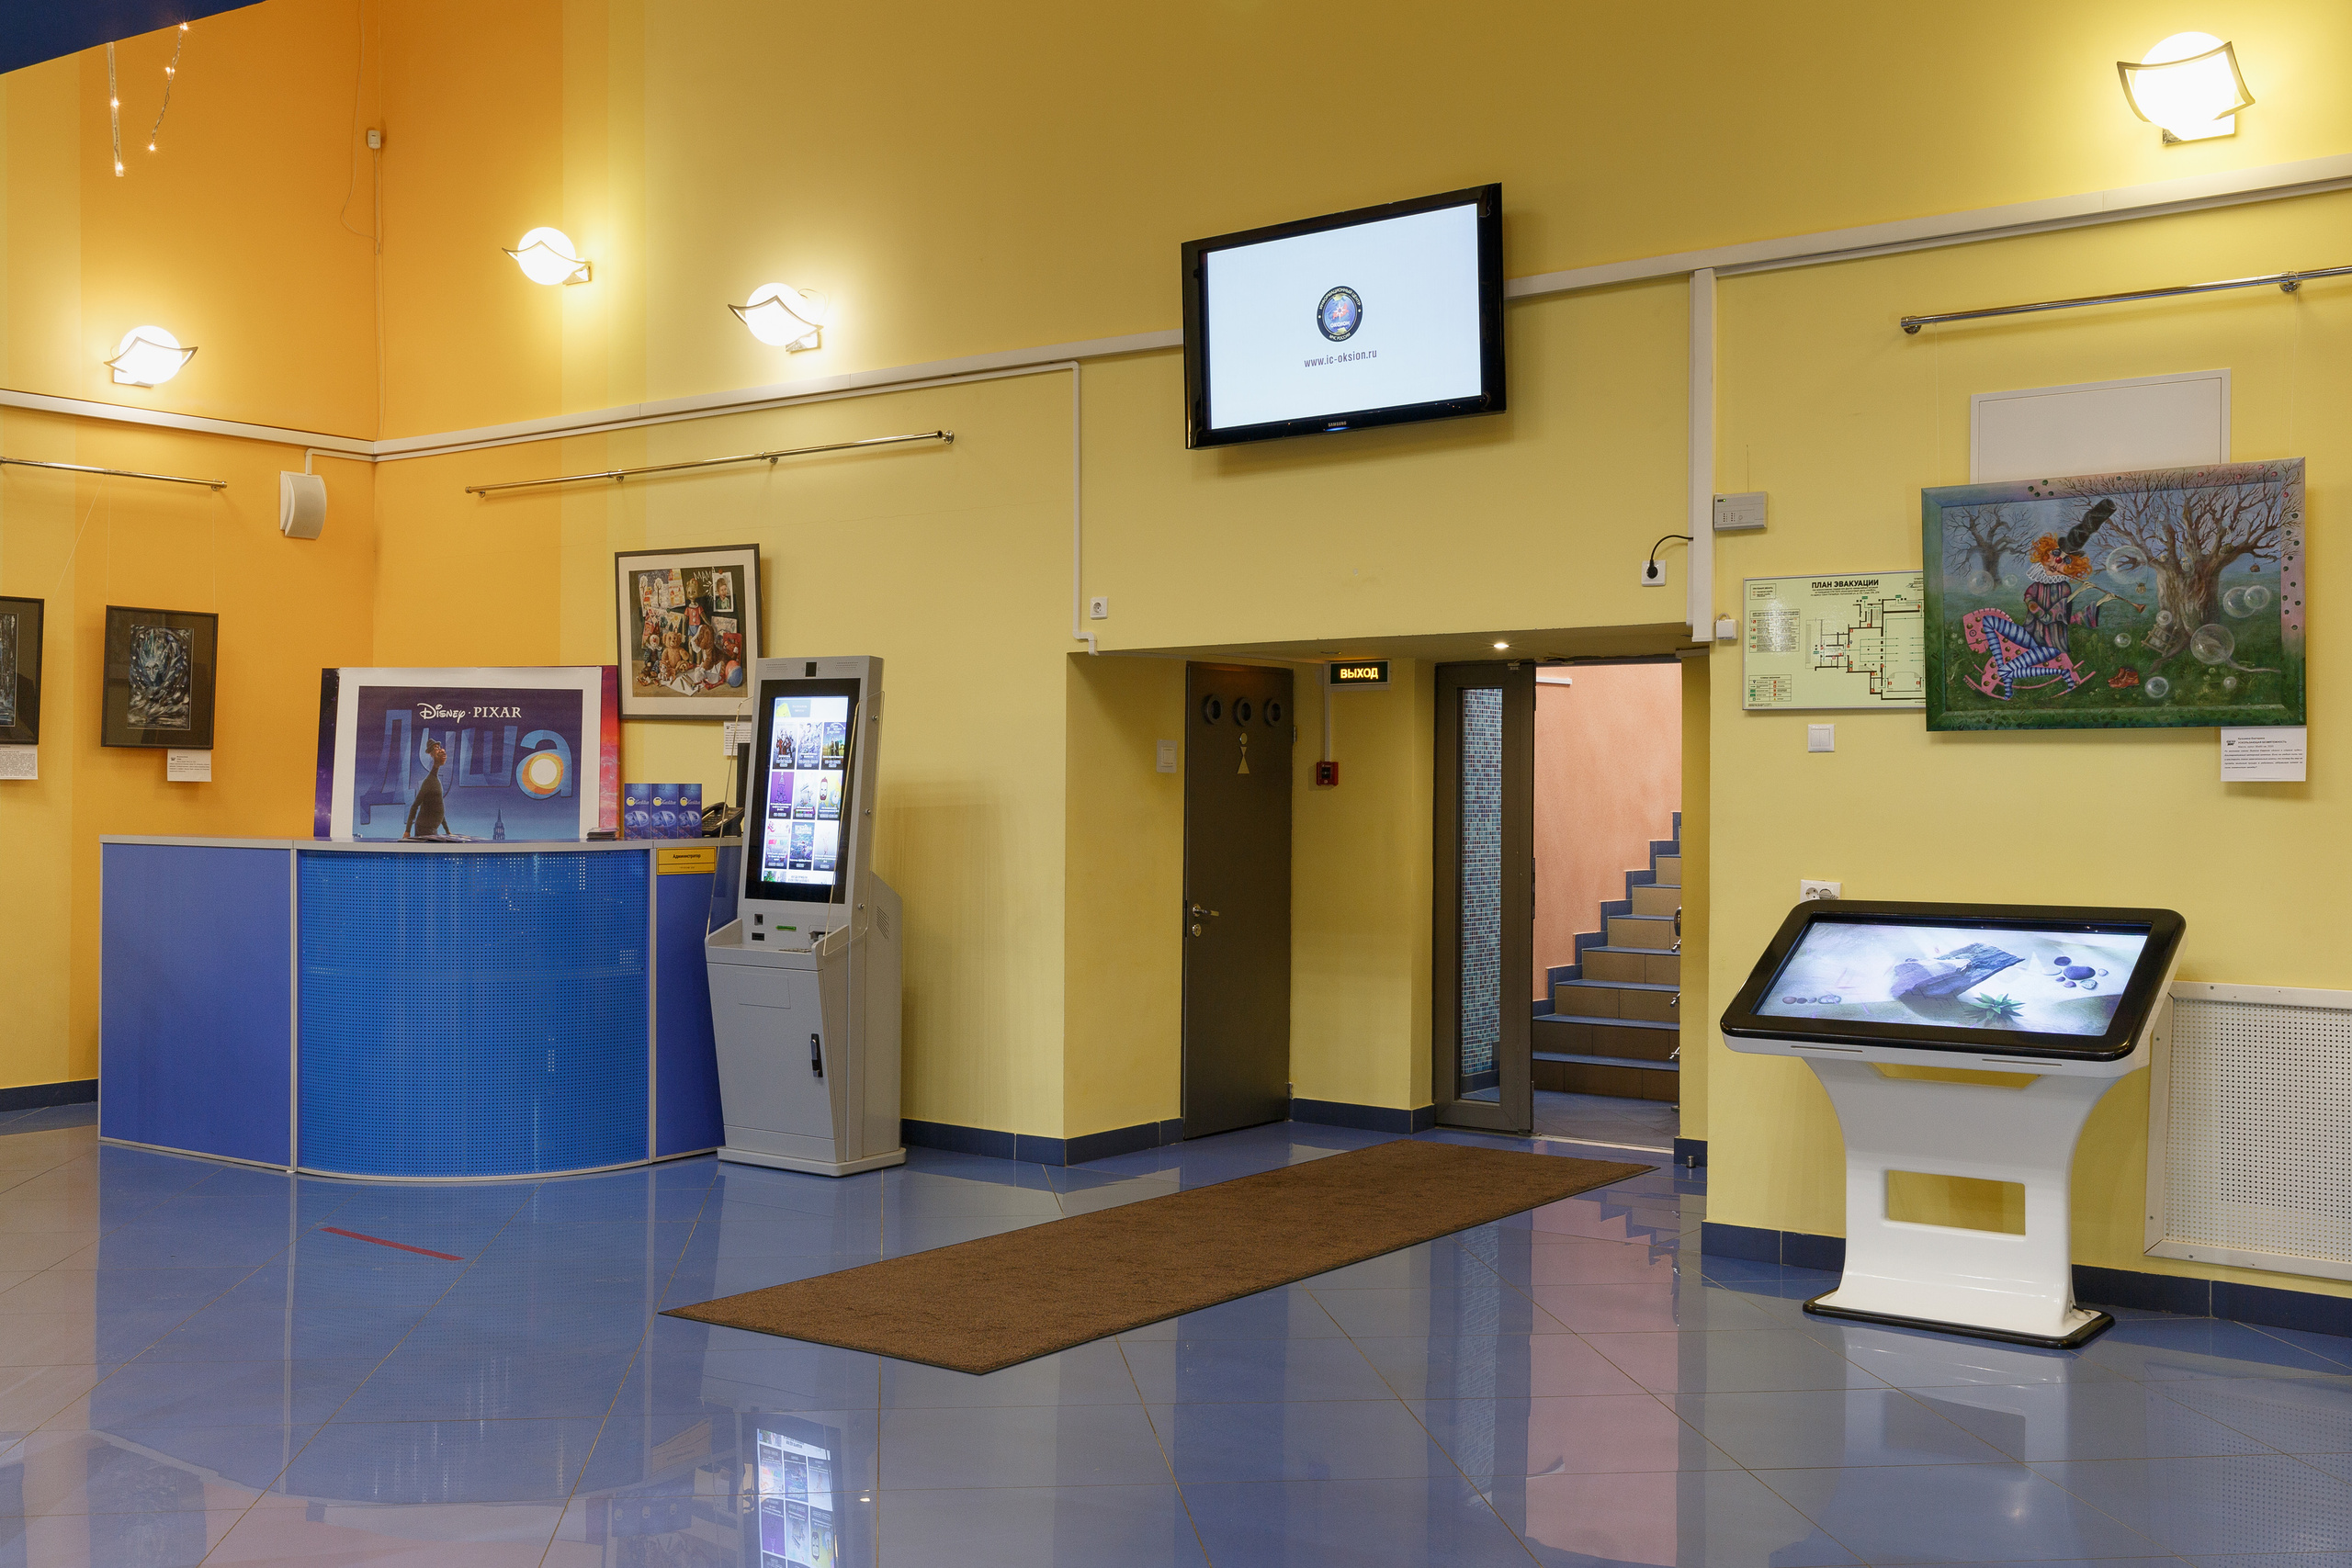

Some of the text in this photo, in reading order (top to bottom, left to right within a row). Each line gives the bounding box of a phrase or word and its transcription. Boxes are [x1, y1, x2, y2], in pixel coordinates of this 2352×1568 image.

[1304, 349, 1377, 367] www.ic-oksion.ru
[1811, 579, 1879, 589] ПЛАН ЭВАКУАЦИИ
[1340, 667, 1379, 680] ВЫХОД
[416, 702, 522, 724] Disney PIXAR
